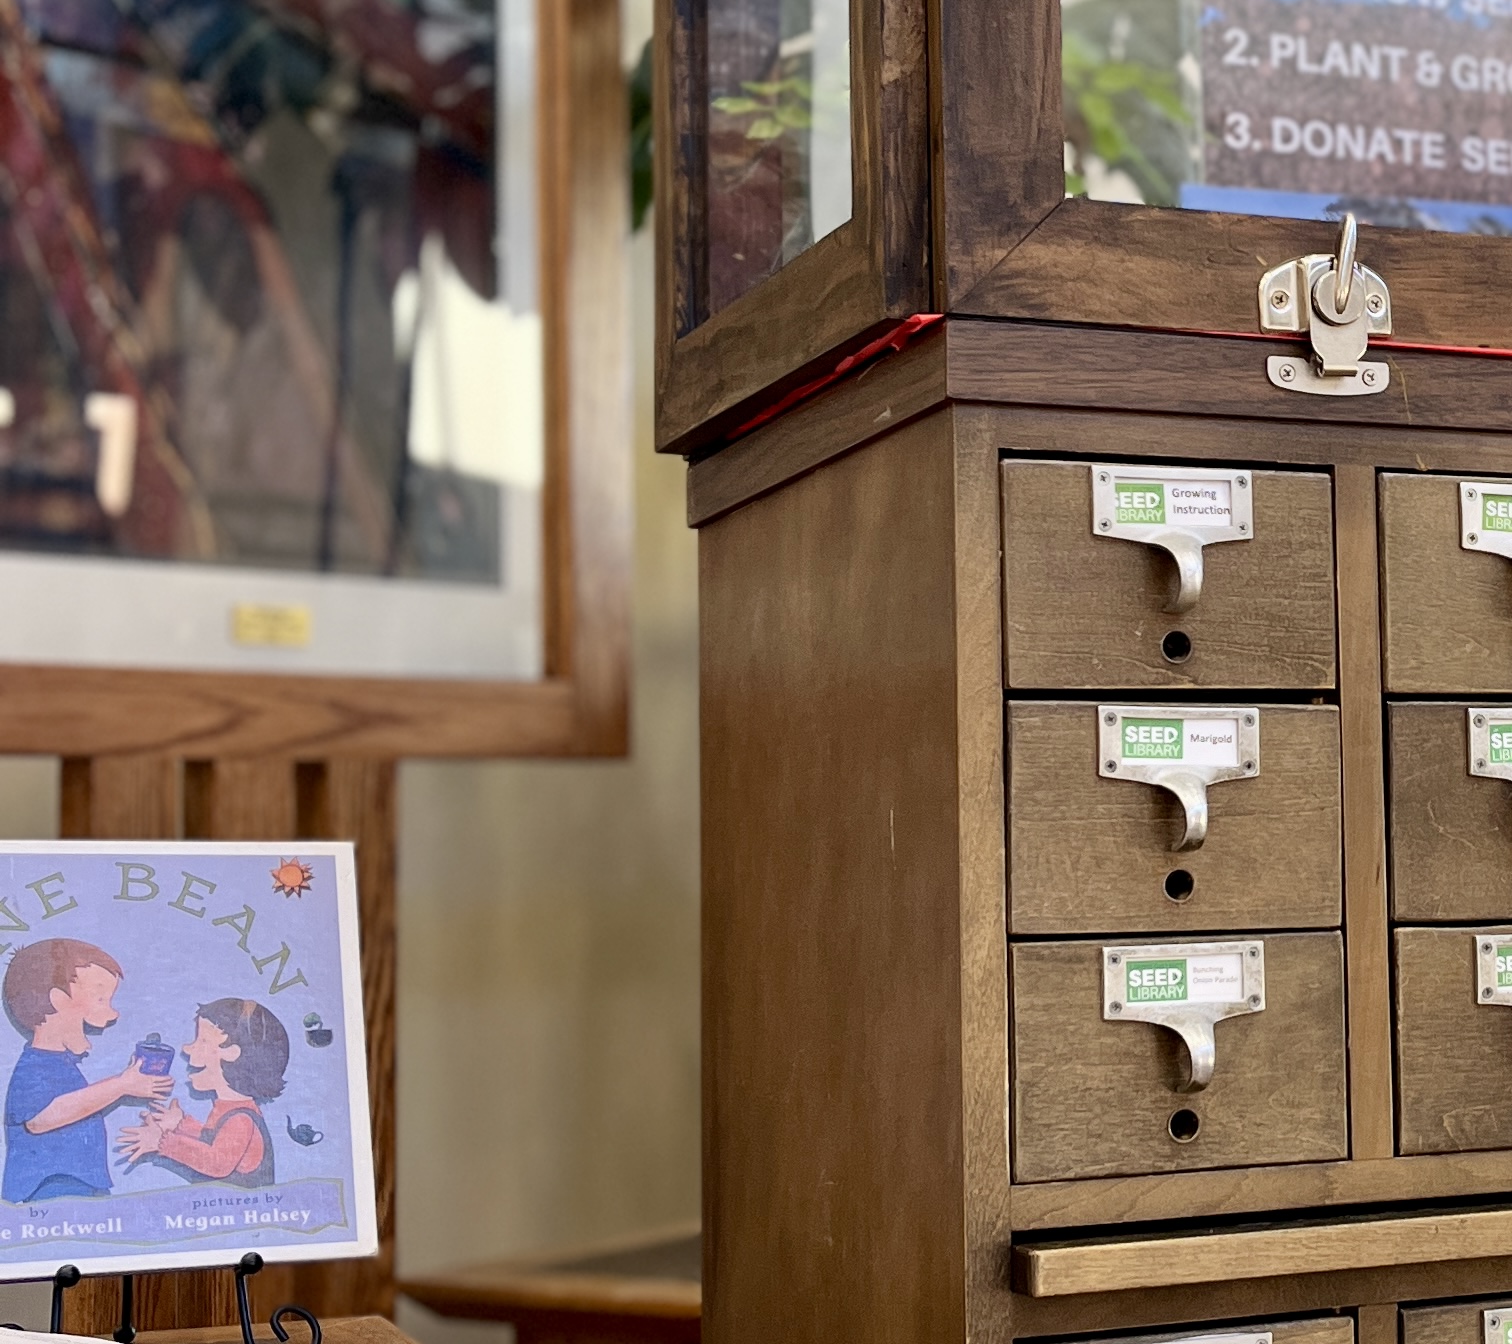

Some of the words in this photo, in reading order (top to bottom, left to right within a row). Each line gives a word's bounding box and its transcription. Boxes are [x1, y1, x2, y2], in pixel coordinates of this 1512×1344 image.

[1223, 28, 1260, 68] 2.
[1269, 35, 1407, 84] PLANT
[1415, 53, 1443, 88] &
[1224, 113, 1262, 152] 3.
[1271, 119, 1446, 171] DONATE
[1172, 489, 1216, 501] Growing
[1125, 726, 1178, 743] SEED
[1190, 734, 1232, 744] Marigold
[1126, 744, 1180, 758] LIBRARY
[112, 861, 309, 996] BEAN
[1129, 968, 1183, 986] SEED
[1130, 986, 1185, 1000] LIBRARY
[192, 1195, 260, 1210] pictures
[264, 1192, 284, 1205] by
[29, 1206, 49, 1219] by
[164, 1213, 236, 1230] Megan
[243, 1207, 312, 1226] Halsey
[21, 1217, 123, 1240] Rockwell
